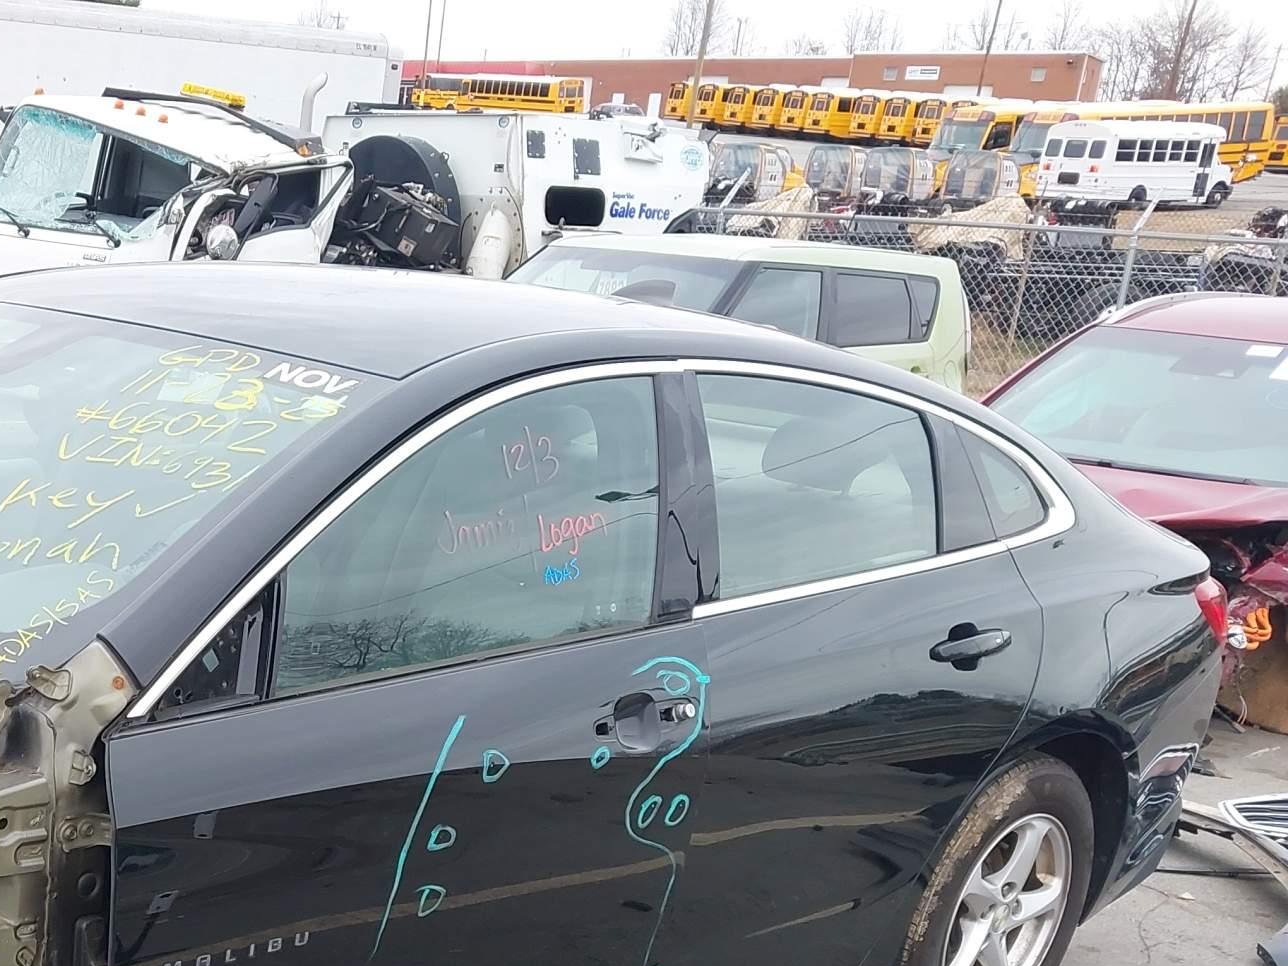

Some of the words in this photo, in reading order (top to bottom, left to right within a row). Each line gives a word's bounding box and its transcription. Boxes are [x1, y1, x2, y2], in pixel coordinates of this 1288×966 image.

[609, 200, 636, 219] Gale
[638, 202, 671, 221] Force
[158, 344, 262, 372] GPD
[501, 425, 560, 484] 12/3
[535, 511, 609, 555] Logan
